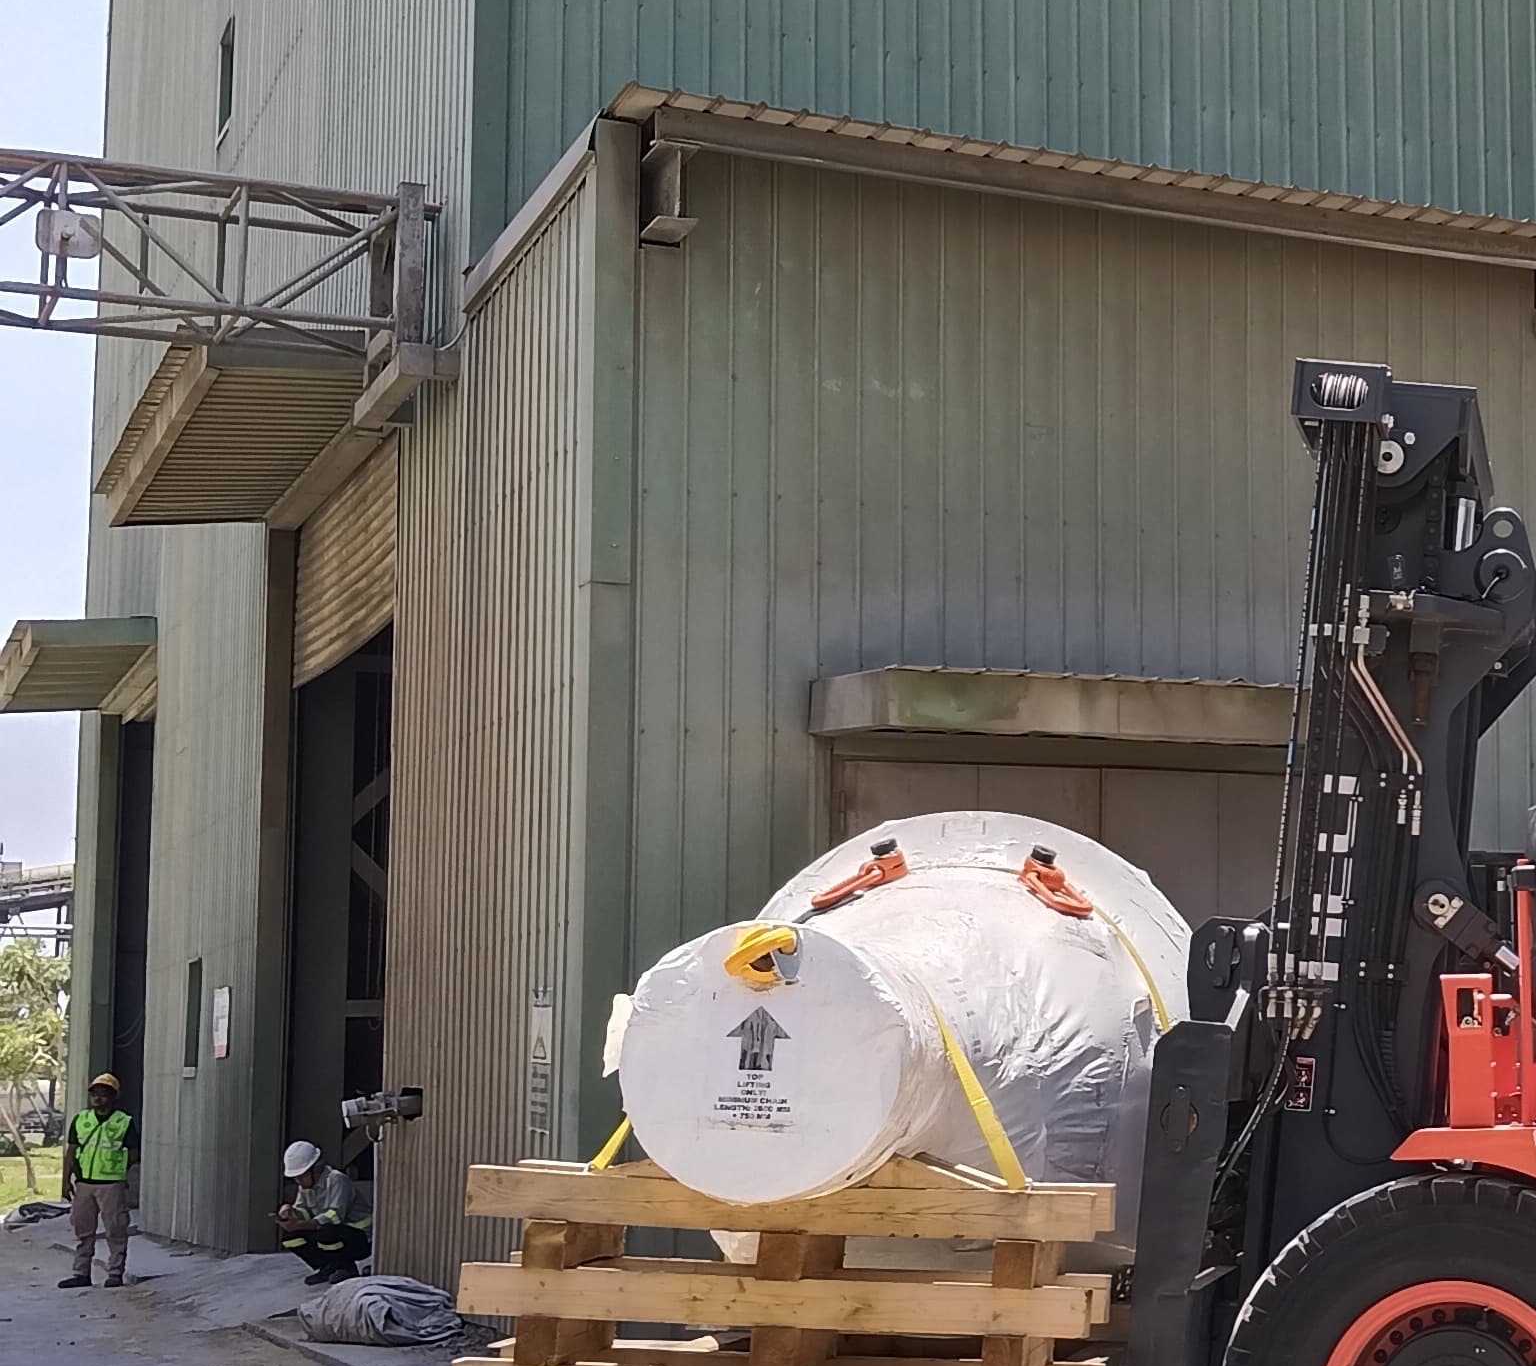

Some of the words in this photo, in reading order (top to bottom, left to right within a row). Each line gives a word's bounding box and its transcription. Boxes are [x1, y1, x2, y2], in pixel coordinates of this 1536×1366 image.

[746, 1073, 764, 1081] TOP
[737, 1081, 771, 1089] LIFTING
[759, 1097, 788, 1105] CHAIN
